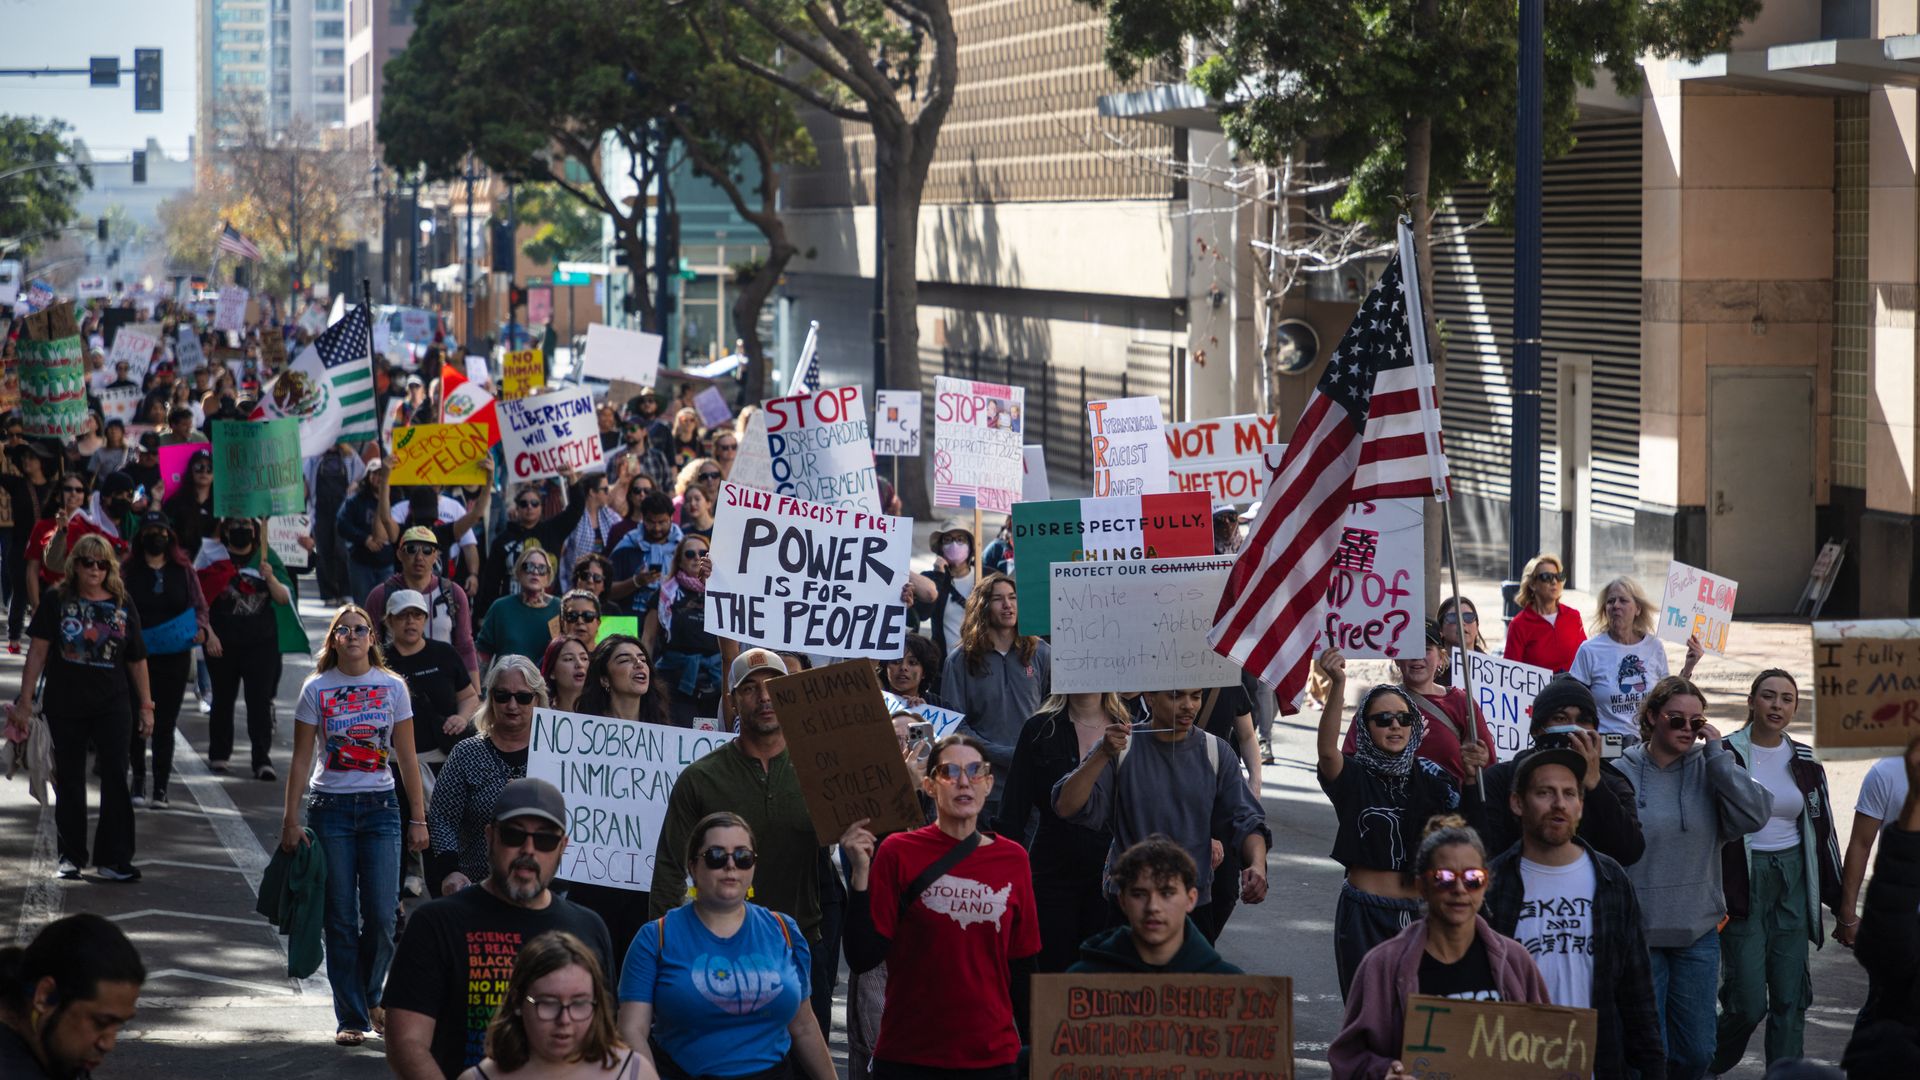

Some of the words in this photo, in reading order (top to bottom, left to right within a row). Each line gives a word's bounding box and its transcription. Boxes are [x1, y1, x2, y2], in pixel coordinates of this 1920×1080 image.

[504, 364, 540, 376] HUMAN
[512, 351, 533, 363] NO
[498, 399, 525, 414] THE
[509, 396, 592, 432] LIBERATION
[765, 386, 858, 433] STOP
[936, 392, 985, 426] STOP
[552, 422, 572, 438] BE
[768, 420, 869, 458] DISREGARDING
[1165, 423, 1220, 459] NOT
[1234, 415, 1277, 455] MY
[415, 423, 488, 484] FELON
[514, 434, 601, 477] COLLECTIVE
[875, 438, 917, 454] TRUMP
[1093, 436, 1148, 467] RACIST
[771, 453, 819, 482] OUR
[725, 484, 771, 512] SILLY
[778, 497, 848, 525] FASCIST
[855, 513, 896, 533] PIG!
[1016, 514, 1205, 538] DISRESPECTFULLY,
[738, 518, 895, 586] POWER
[1071, 546, 1158, 562] CHINGA
[1055, 566, 1113, 577] PROTECT
[1118, 565, 1146, 575] OUR
[764, 576, 791, 597] IS
[802, 581, 852, 603] FOR
[1062, 584, 1129, 611] White
[1156, 584, 1204, 605] Cis
[1697, 576, 1736, 613] ELON
[706, 590, 765, 639] THE
[783, 601, 905, 650] PEOPLE
[1061, 614, 1120, 644] Rich
[1667, 606, 1688, 628] The
[1324, 608, 1411, 658] free?
[1817, 643, 1843, 668] I
[1853, 643, 1904, 667] fully
[776, 689, 797, 707] NO
[802, 668, 870, 702] HUMAN
[1610, 694, 1624, 704] WE
[1625, 694, 1641, 703] ARE
[1817, 675, 1858, 697] the
[1480, 687, 1518, 724] RN
[802, 717, 817, 736] IS
[819, 703, 880, 733] ILLEGAL
[533, 713, 573, 754] NO
[577, 719, 664, 762] SOBRAN
[815, 751, 841, 770] ON
[822, 762, 893, 801] STOLEN
[831, 800, 881, 827] LAND
[924, 885, 981, 899] STOLEN
[950, 900, 993, 915] LAND
[1519, 897, 1593, 921] SKAT
[466, 932, 522, 944] SCIENCE
[1546, 919, 1581, 930] AND
[468, 944, 481, 954] IS
[484, 944, 518, 955] REAL
[469, 956, 513, 967] BLACK
[468, 981, 491, 993] NO
[468, 994, 481, 1005] IS
[467, 1006, 497, 1018] LOV
[1161, 984, 1236, 1018] BELIEF
[1239, 986, 1280, 1020] IN
[1051, 1019, 1187, 1056] AUTHORITY
[1186, 1025, 1221, 1058] IS
[1226, 1024, 1280, 1060] THE
[1405, 1004, 1452, 1054] I
[1468, 1014, 1587, 1070] March
